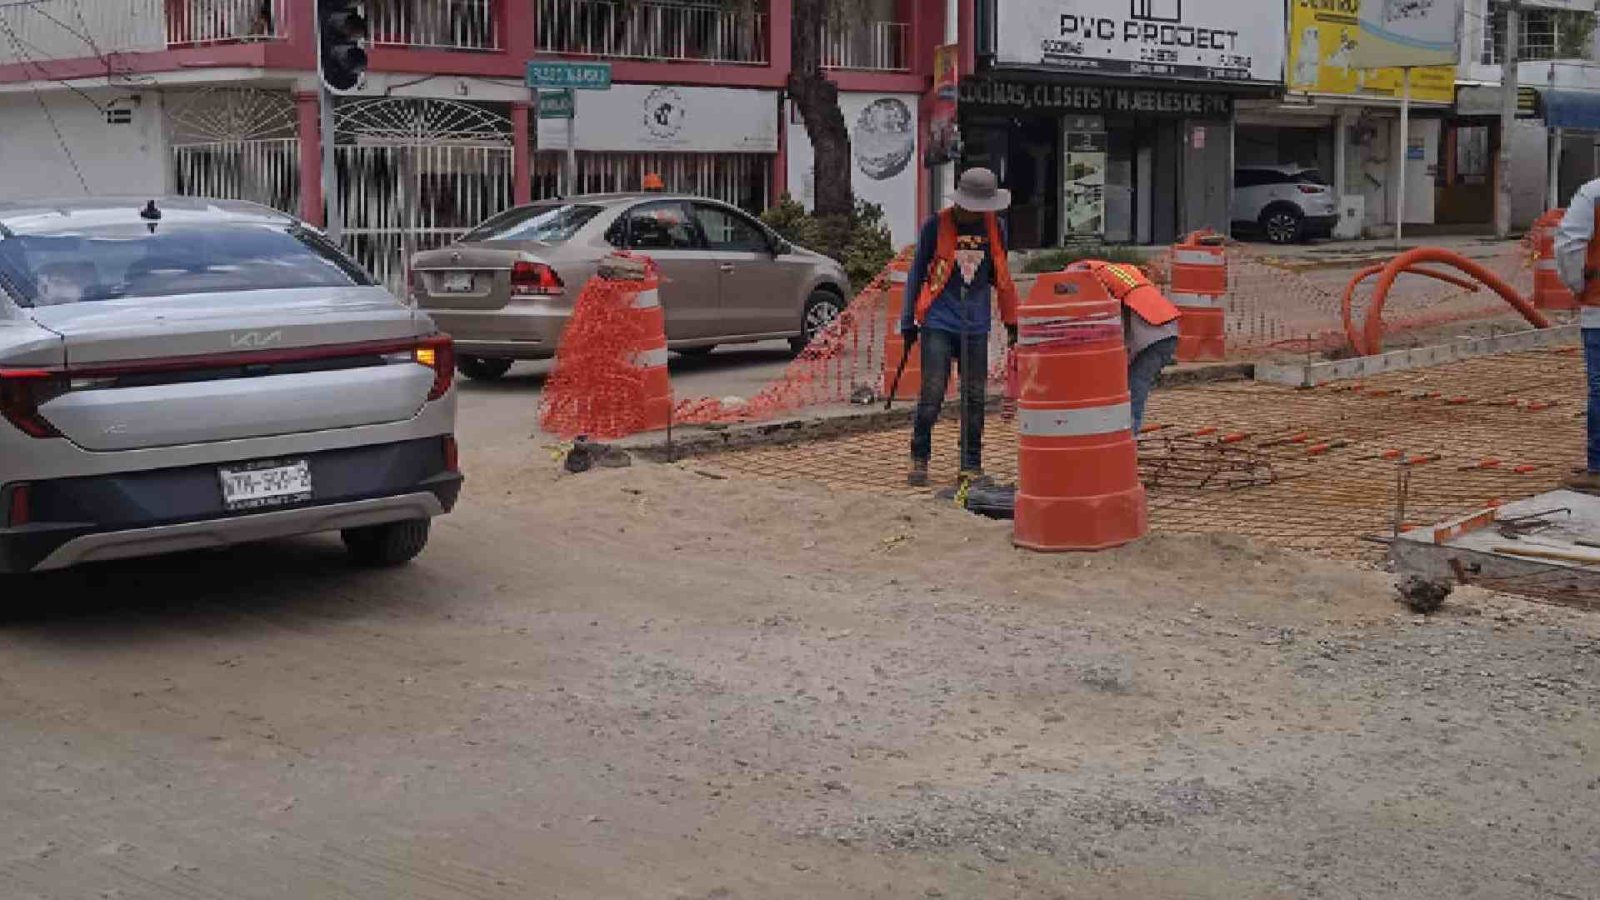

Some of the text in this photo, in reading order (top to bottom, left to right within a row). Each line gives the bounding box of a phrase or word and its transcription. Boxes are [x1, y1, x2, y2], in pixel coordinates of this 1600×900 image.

[1061, 14, 1238, 50] PVC PROJECT
[1034, 86, 1101, 108] CLOSETS
[1106, 88, 1114, 109] Y
[1117, 90, 1182, 111] MUEBLES
[1184, 92, 1202, 112] DE
[1204, 94, 1229, 113] PVC
